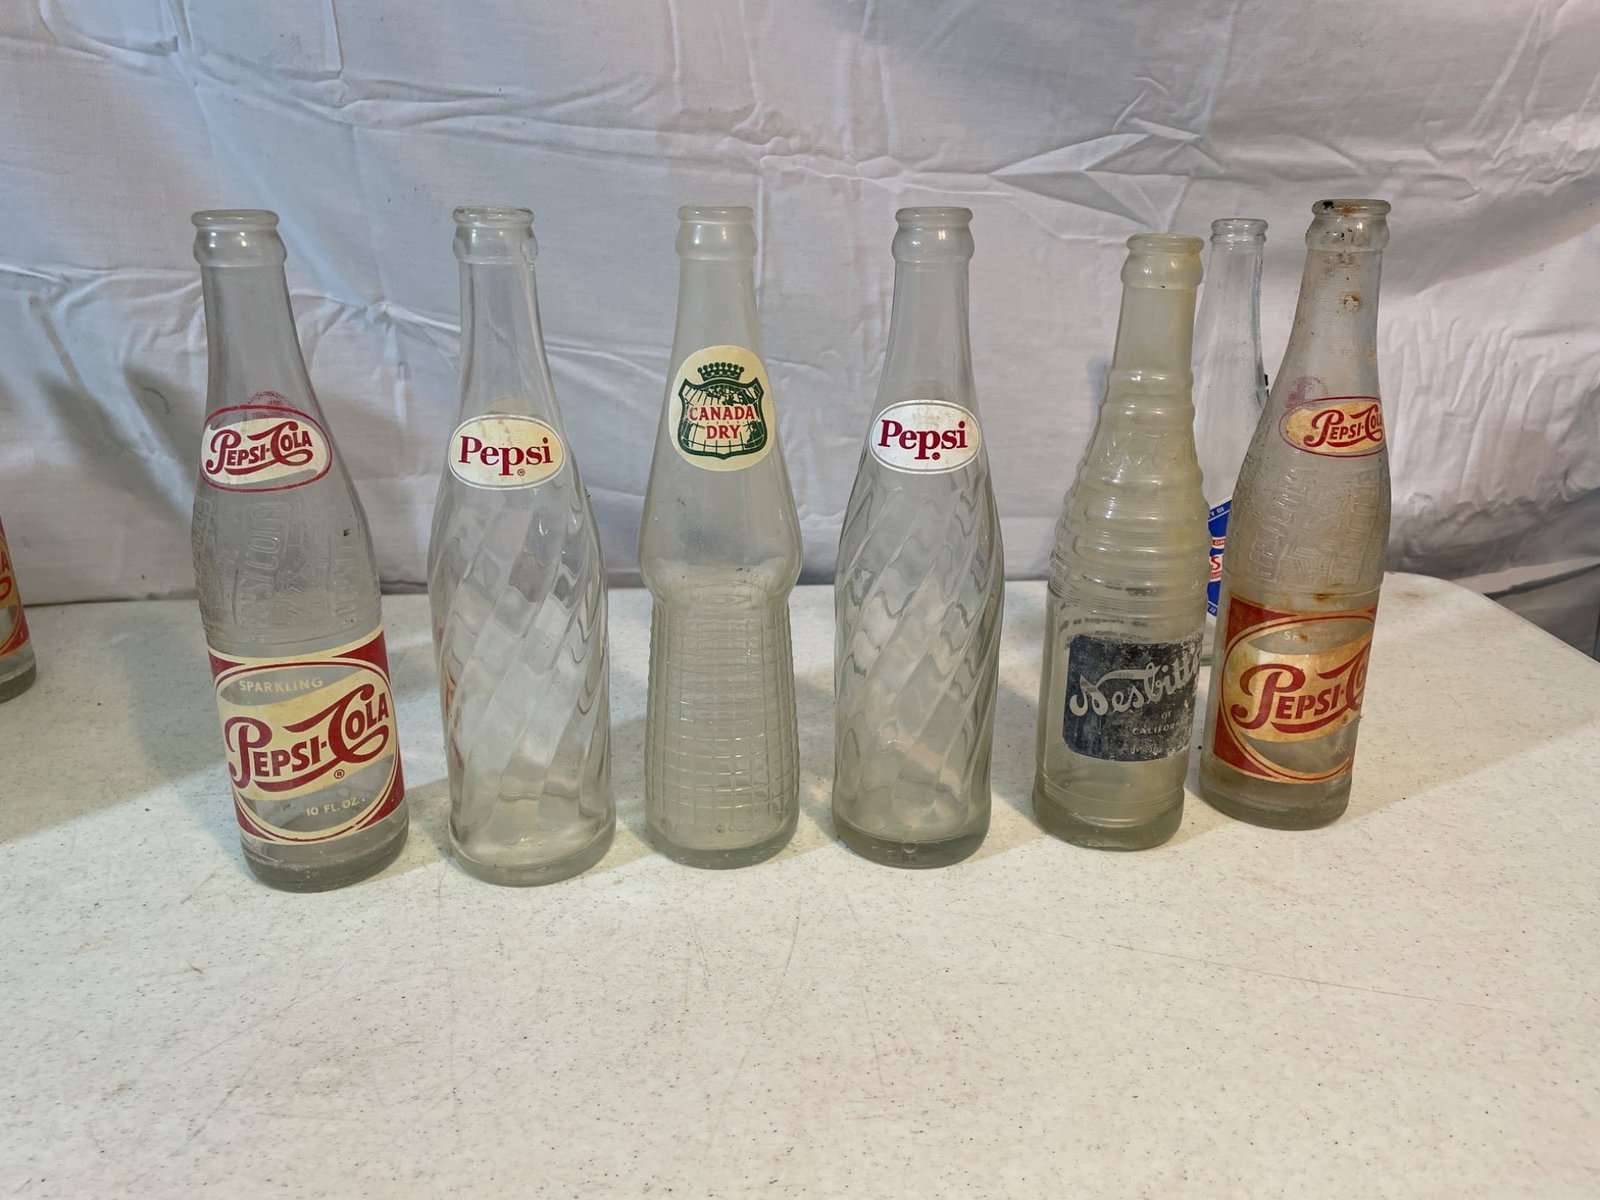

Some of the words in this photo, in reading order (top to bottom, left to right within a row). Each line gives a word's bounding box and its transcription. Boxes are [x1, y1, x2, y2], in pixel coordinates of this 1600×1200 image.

[689, 405, 755, 420] CANADA
[706, 424, 741, 439] DRY
[1303, 403, 1384, 448] PEPSI-COL
[206, 421, 313, 476] PEPSI-COLA
[458, 435, 553, 476] Pepsi
[878, 419, 968, 460] Pepsi
[239, 677, 324, 692] SPARKLING
[1231, 641, 1371, 733] PEPSI-CO
[224, 683, 390, 792] PEPSI-COLA
[306, 807, 319, 817] 10
